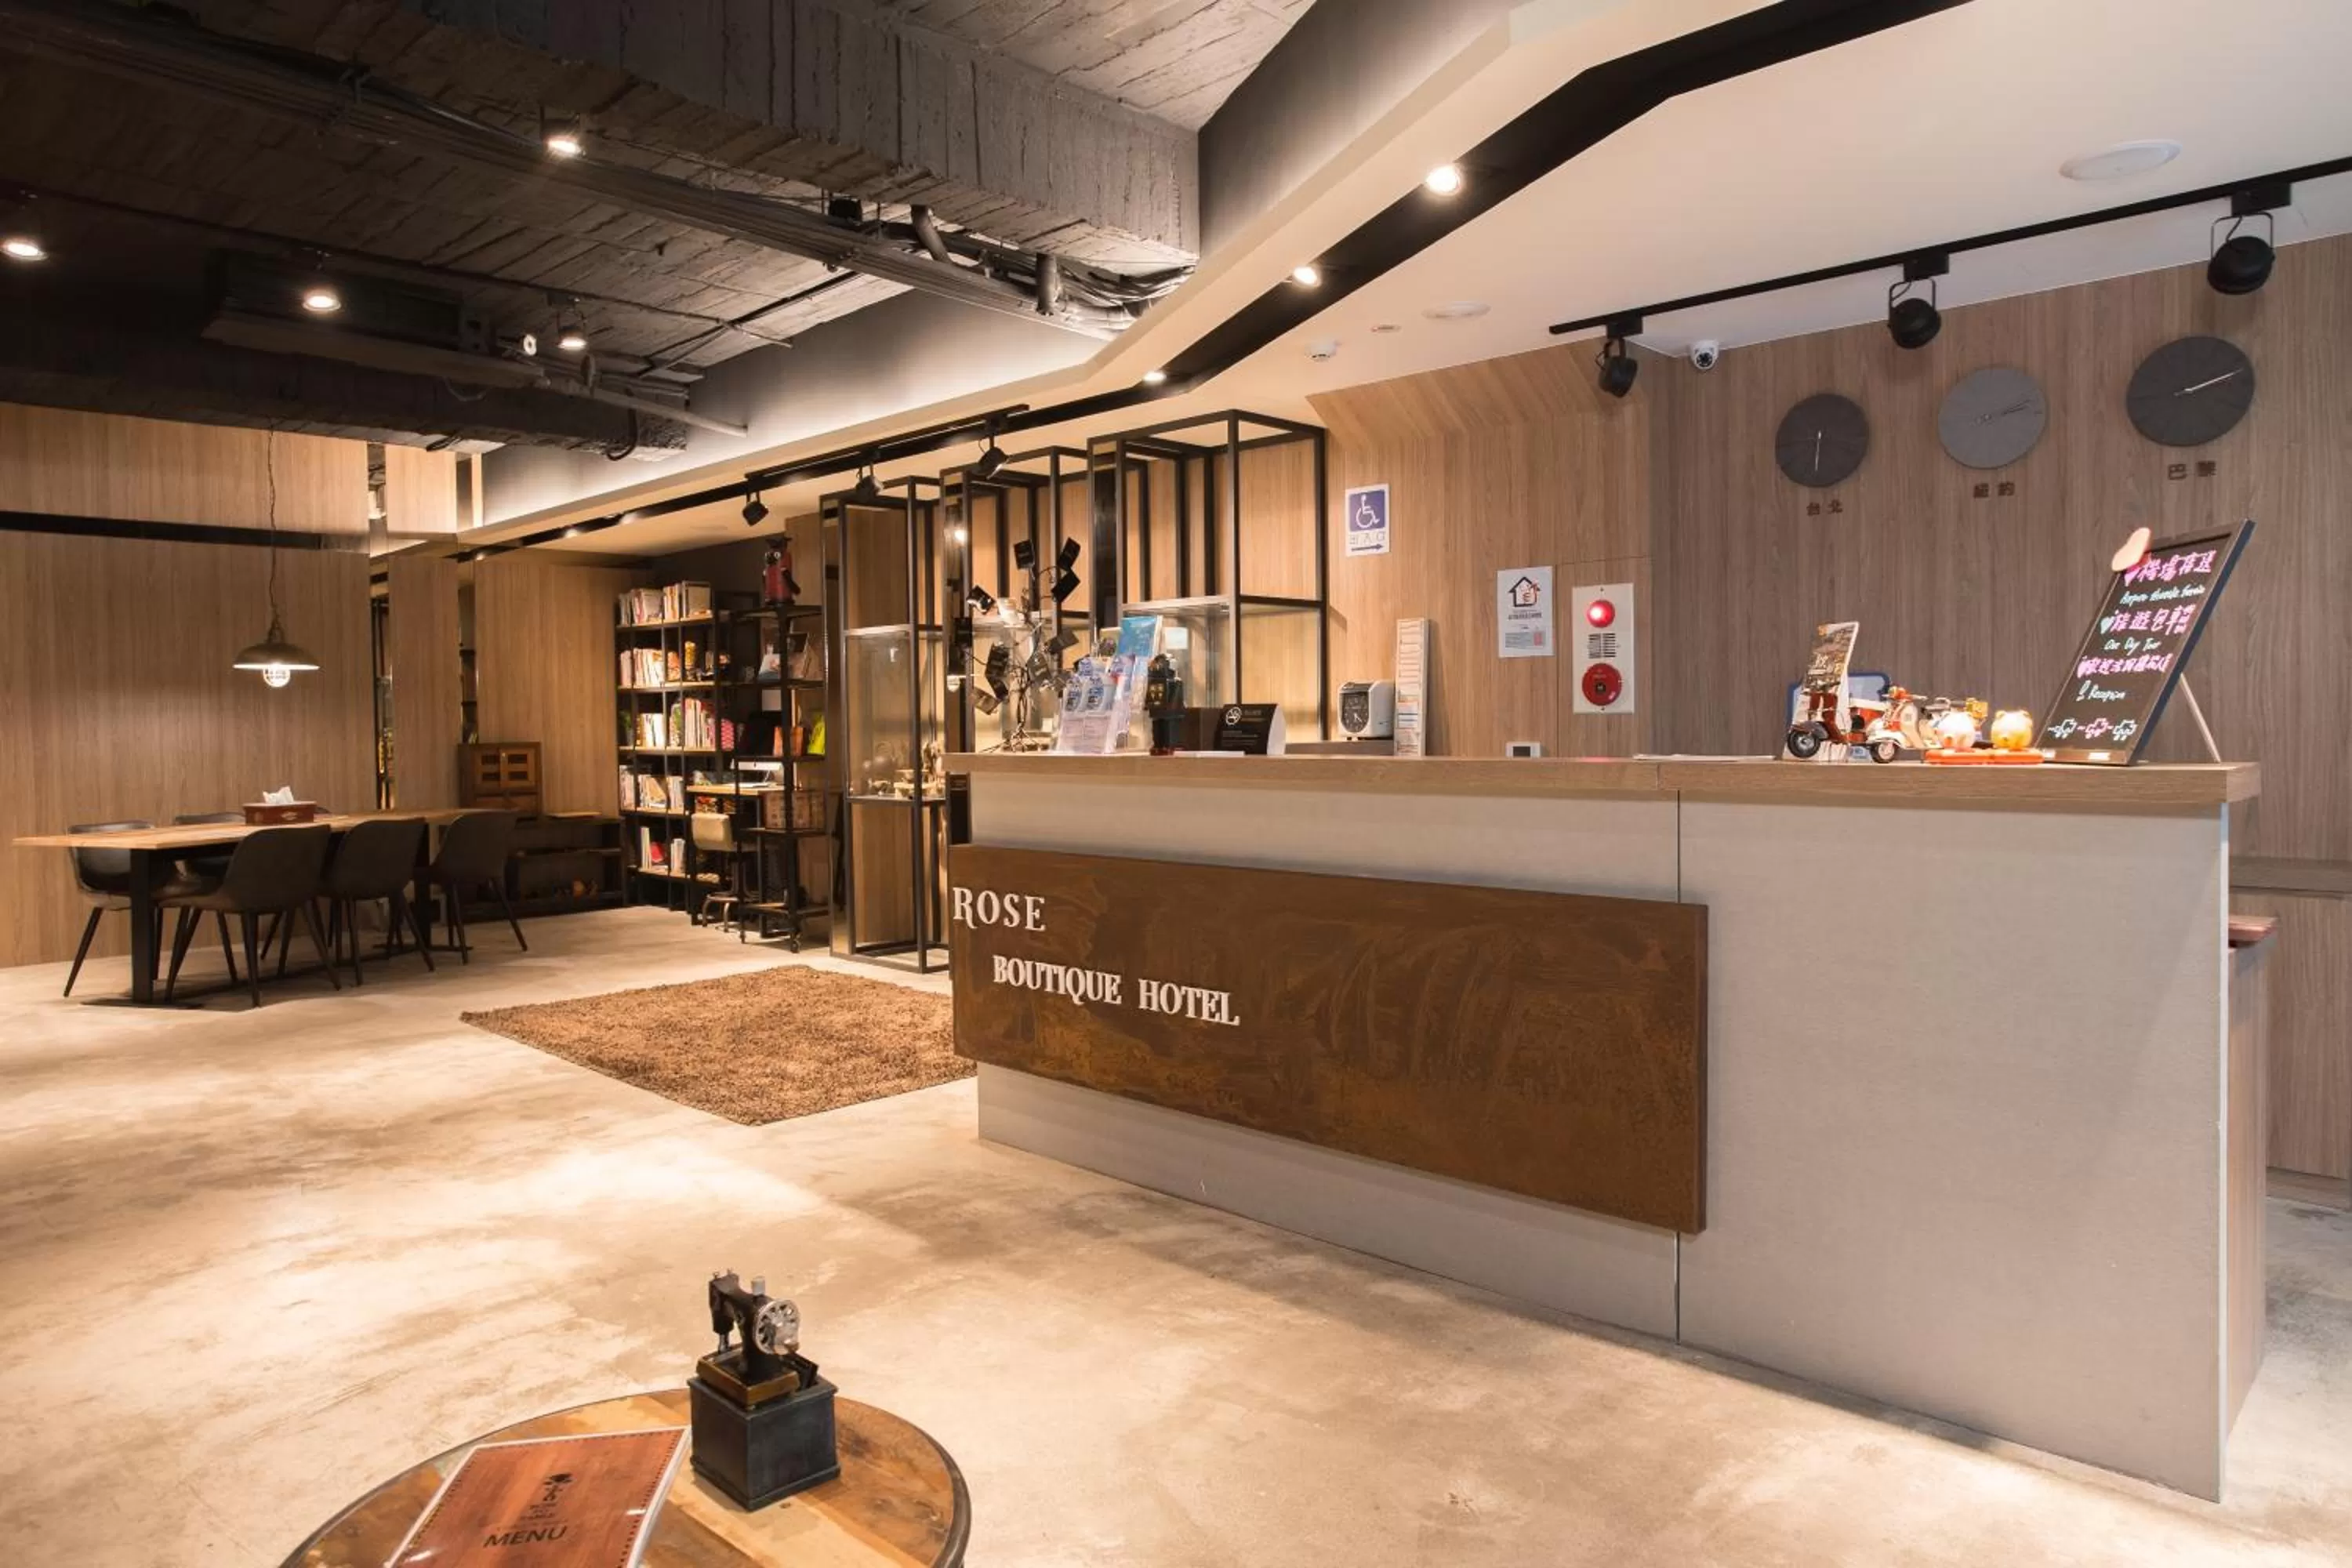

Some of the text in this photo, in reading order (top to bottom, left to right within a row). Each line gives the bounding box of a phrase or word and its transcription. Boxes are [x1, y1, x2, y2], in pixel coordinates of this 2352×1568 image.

[2168, 461, 2216, 481] 巴黎
[1973, 482, 2015, 499] 紐約
[953, 887, 1046, 931] ROSE
[993, 955, 1240, 1025] BOUTIQUE HOTEL
[484, 1526, 567, 1547] MENU
